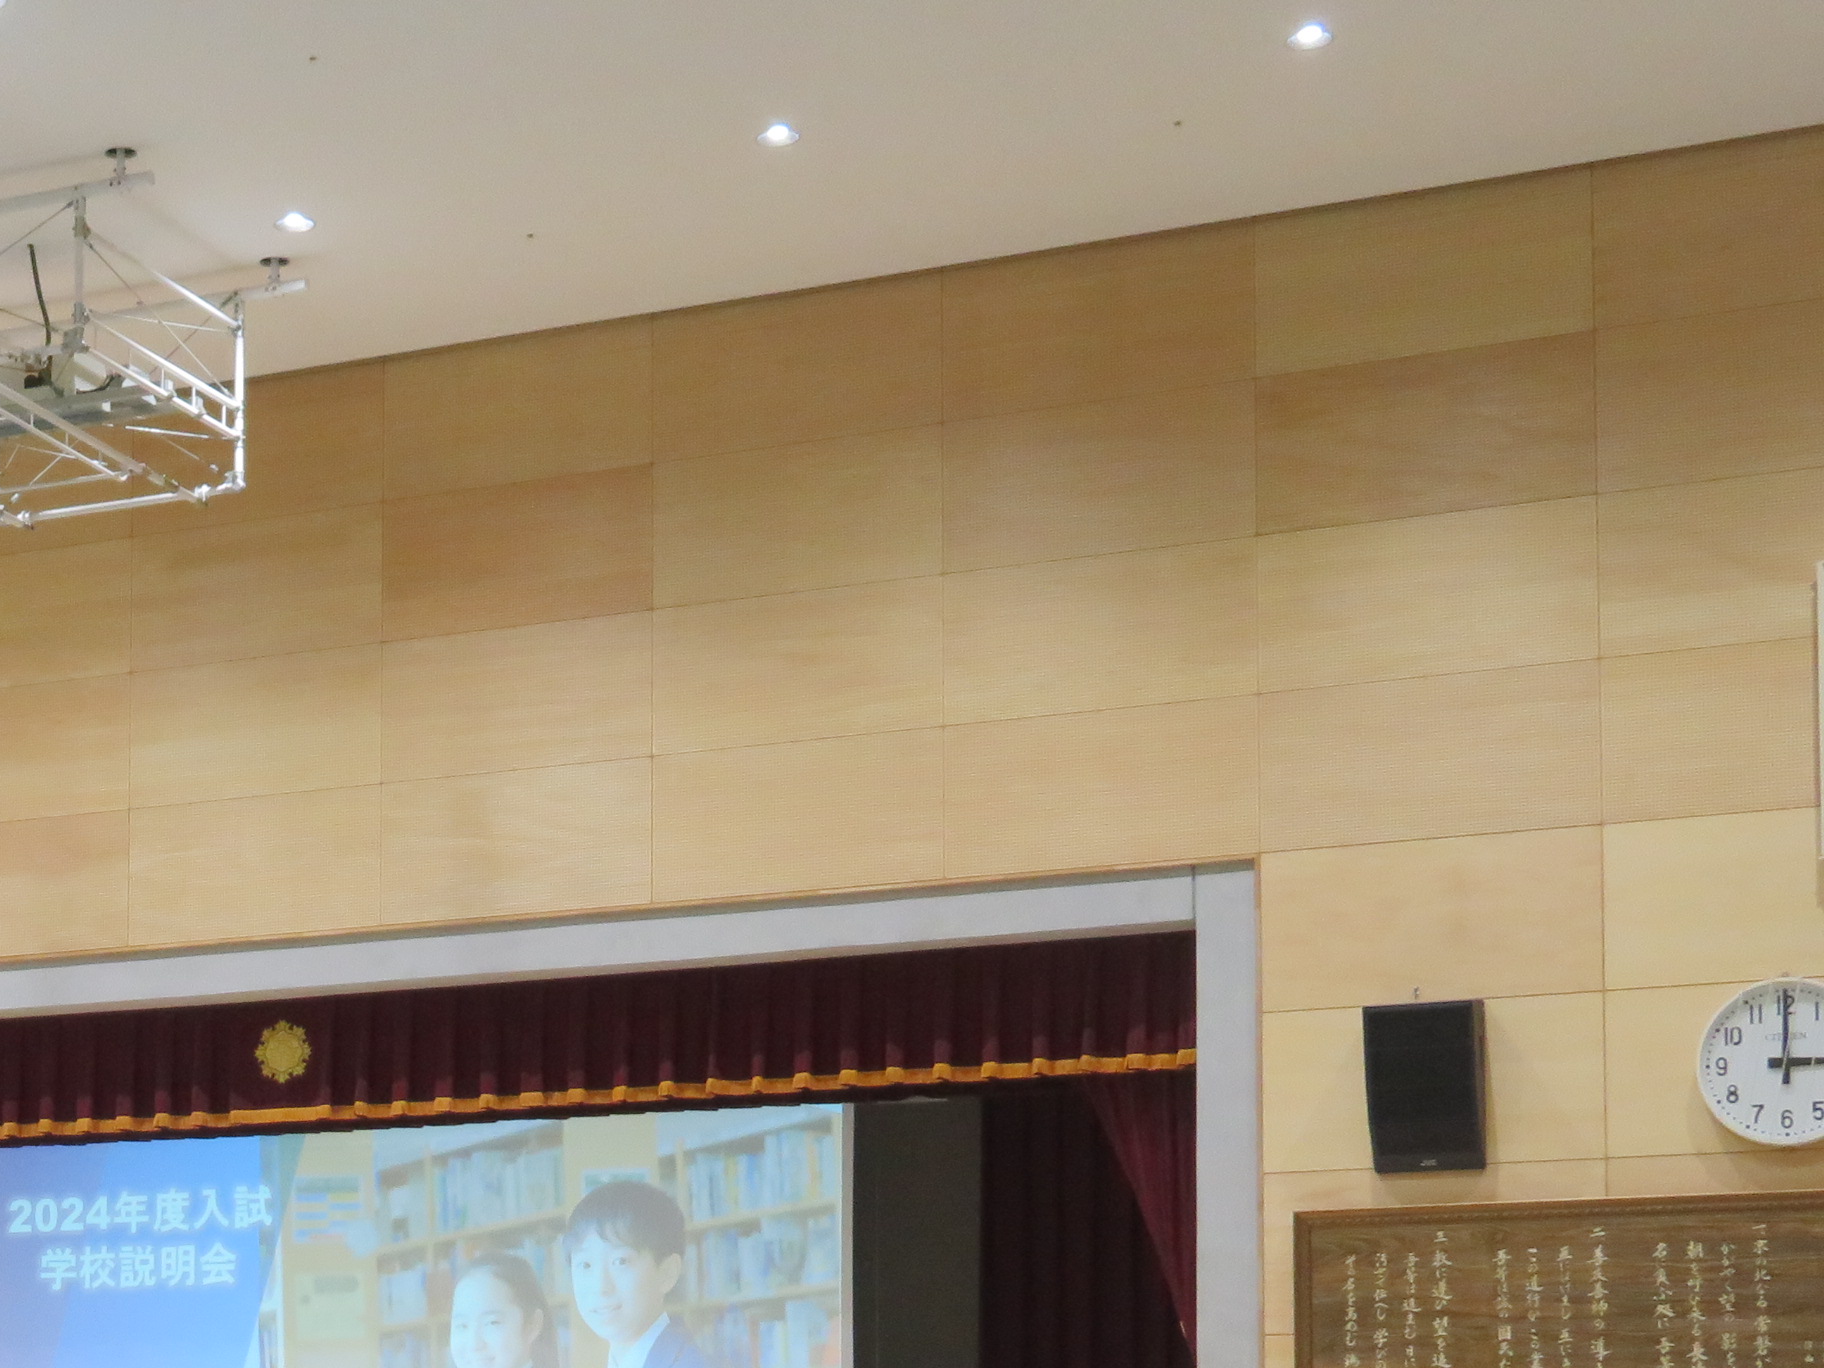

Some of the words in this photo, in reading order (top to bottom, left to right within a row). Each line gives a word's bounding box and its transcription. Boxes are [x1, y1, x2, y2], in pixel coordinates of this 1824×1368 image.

[1749, 1004, 1763, 1024] 11
[1724, 1026, 1743, 1046] 10
[1715, 1057, 1728, 1077] 9
[1726, 1084, 1739, 1104] 8
[1751, 1104, 1765, 1124] 7
[1780, 1109, 1794, 1129] 6
[1812, 1101, 1824, 1121] 5
[8, 1185, 273, 1234] 2024年度入試
[39, 1242, 237, 1292] 学校説明会
